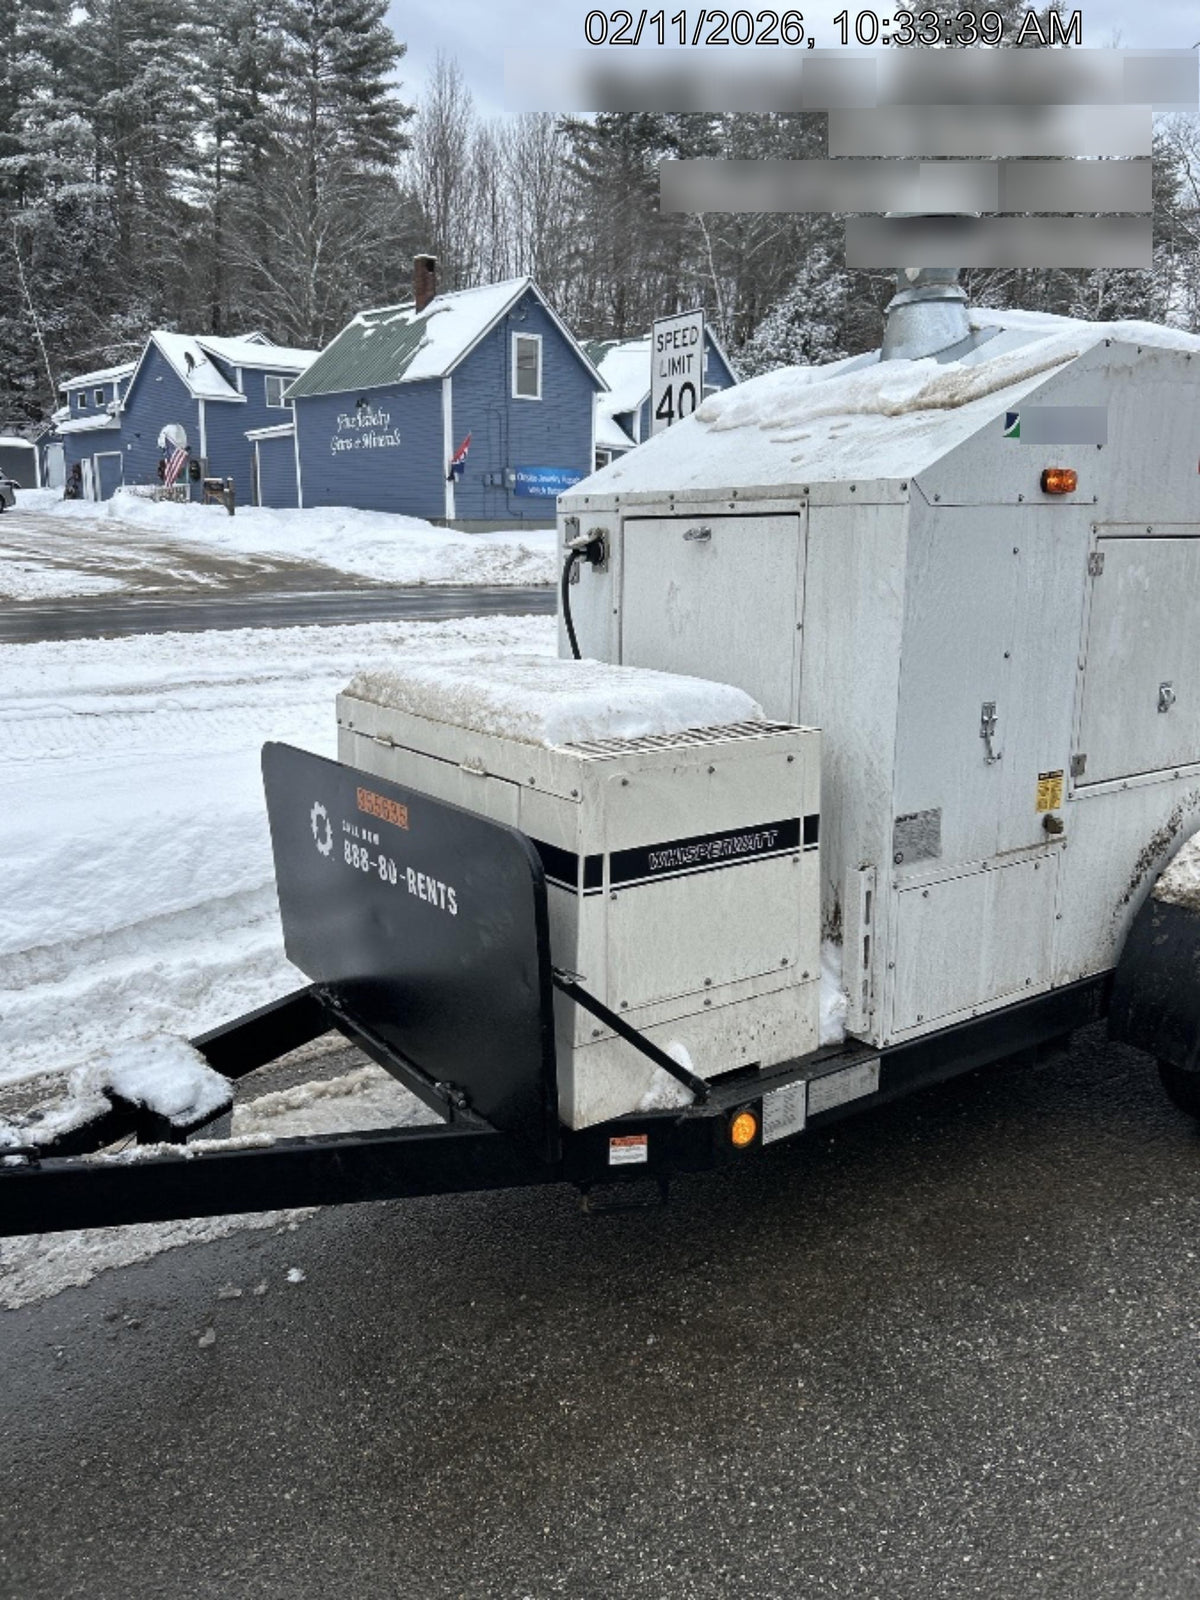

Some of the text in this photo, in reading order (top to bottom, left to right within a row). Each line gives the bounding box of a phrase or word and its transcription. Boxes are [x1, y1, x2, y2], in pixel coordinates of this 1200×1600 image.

[656, 326, 699, 353] SPEED
[660, 353, 694, 378] LIMIT
[655, 381, 697, 428] 40
[648, 829, 779, 871] WHISPERWATT
[343, 839, 458, 916] 888-80-RENTS
